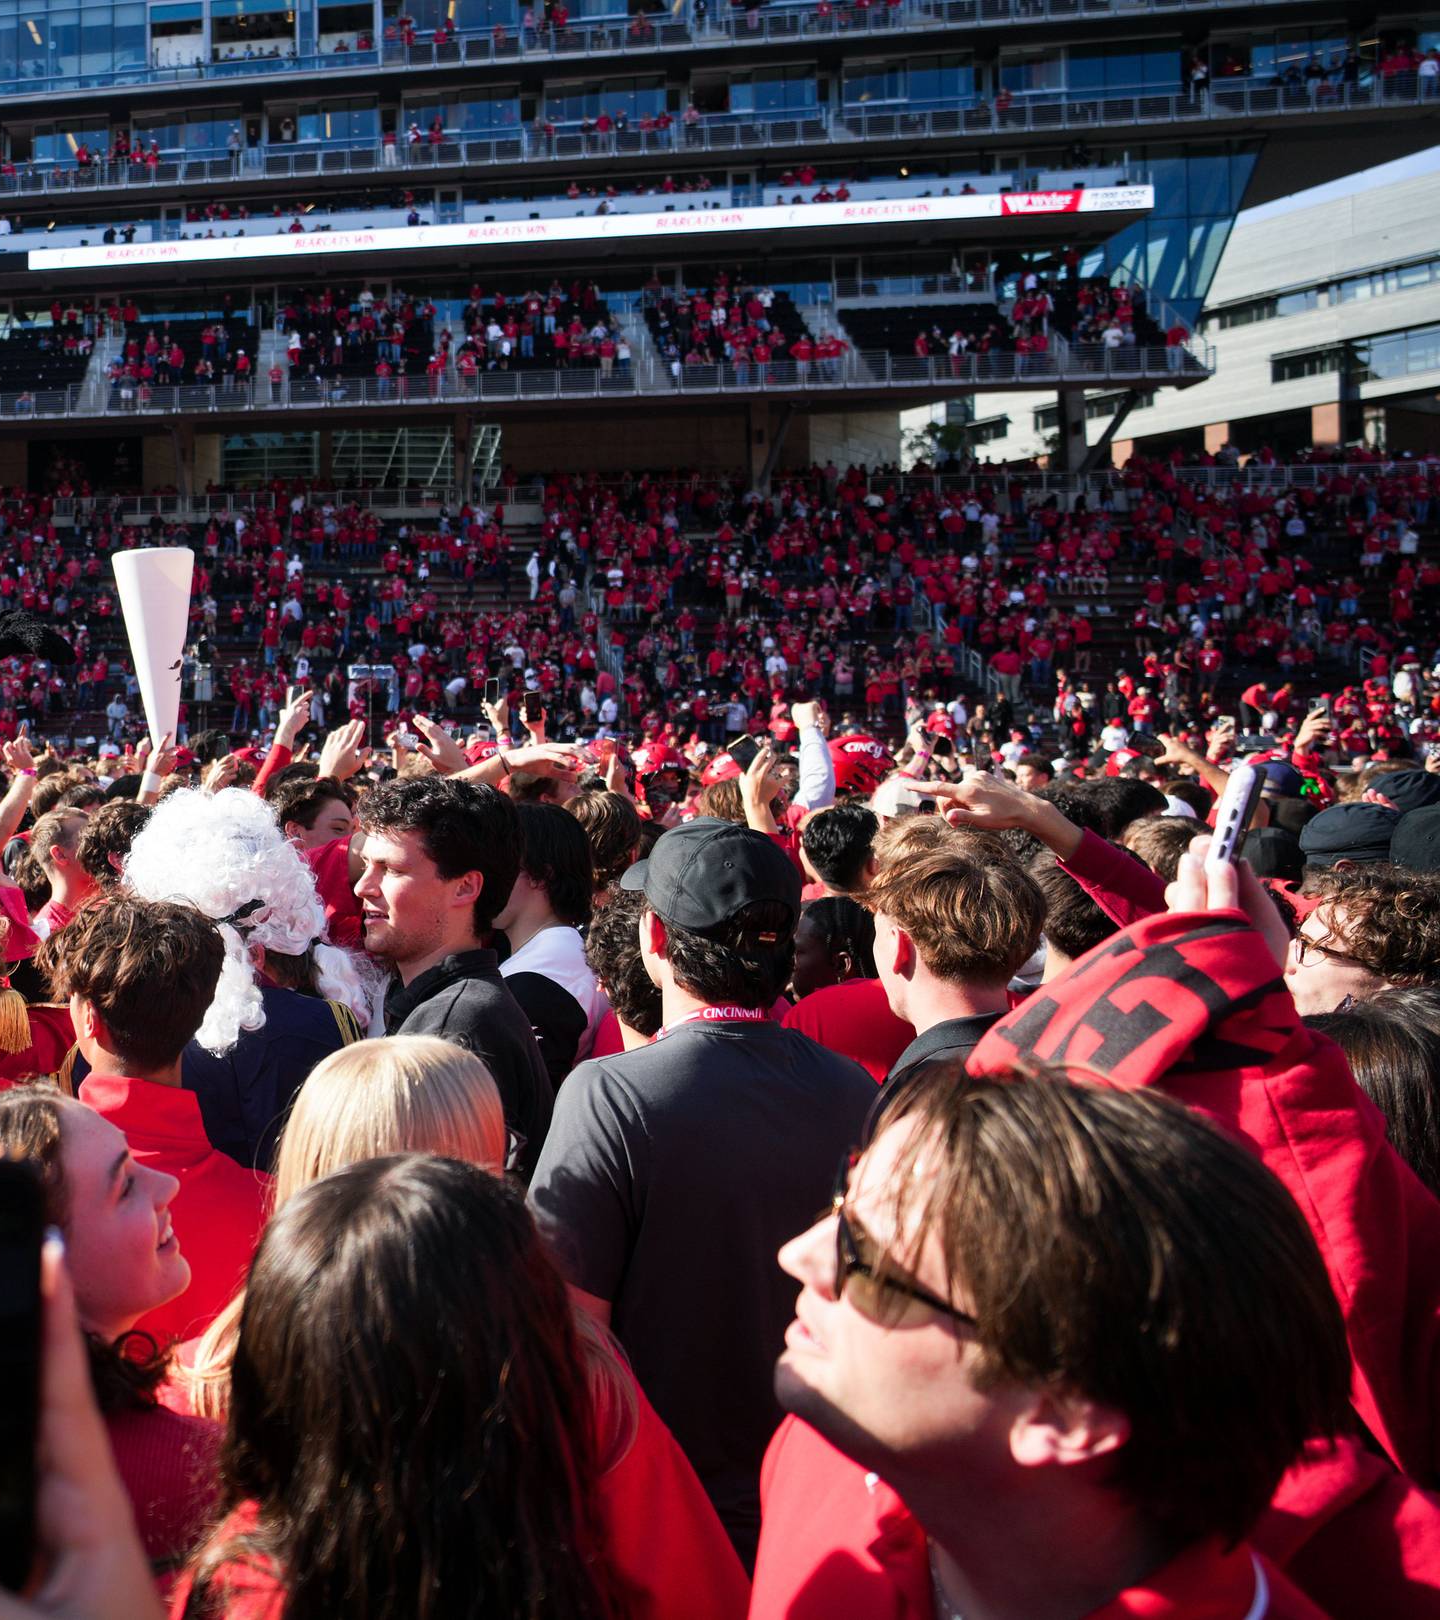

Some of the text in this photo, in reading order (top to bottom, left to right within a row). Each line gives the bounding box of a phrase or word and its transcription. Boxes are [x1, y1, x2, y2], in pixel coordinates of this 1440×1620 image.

[843, 204, 929, 217] BEARCATS WIN
[655, 213, 743, 227] BEARCATS WIN
[467, 225, 546, 238] BEARCATS WIN
[294, 234, 375, 248] BEARCATS WIN
[105, 246, 178, 259] BEARCATS WIN
